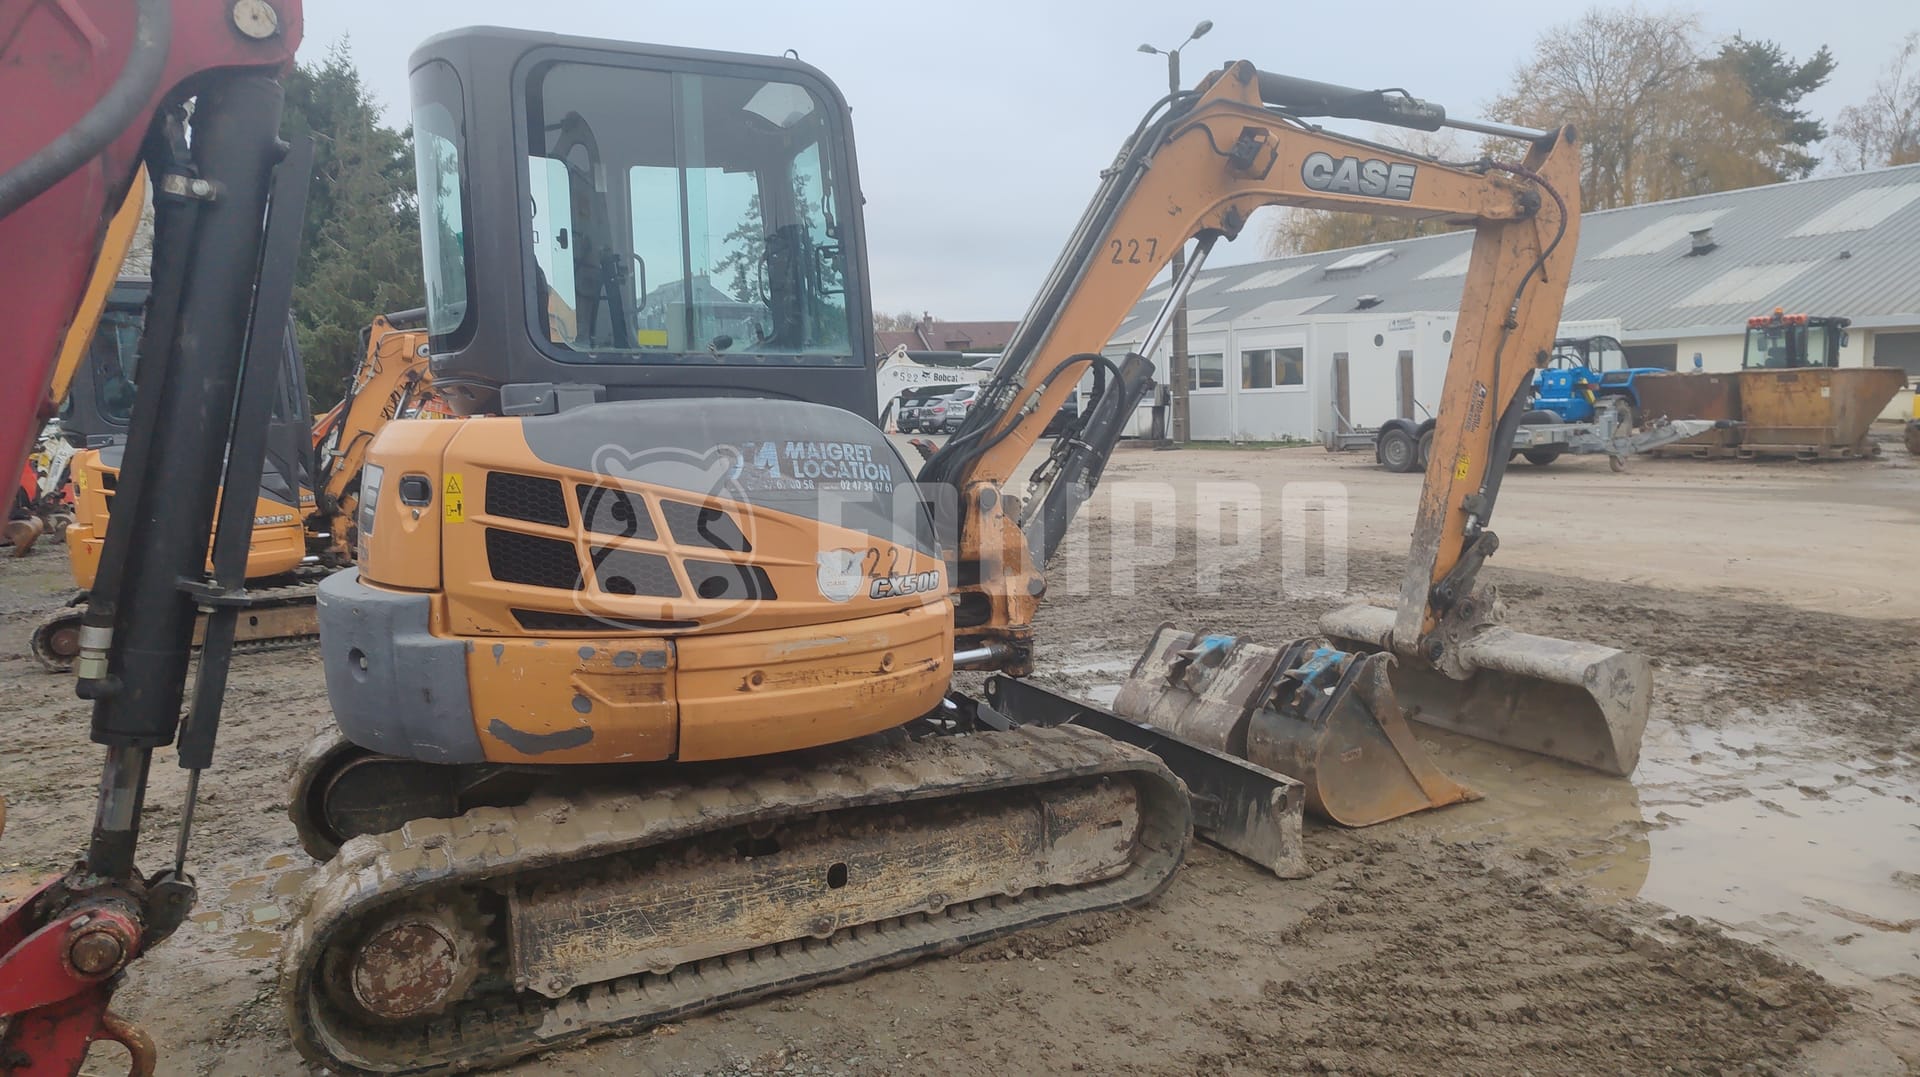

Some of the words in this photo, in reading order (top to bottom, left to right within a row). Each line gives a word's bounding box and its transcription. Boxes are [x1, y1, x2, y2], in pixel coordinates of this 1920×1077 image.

[1301, 151, 1418, 200] CASE
[1110, 237, 1158, 264] 227
[933, 373, 958, 382] Bobcat
[785, 441, 872, 462] MAIGRET
[793, 460, 891, 481] LOCATION
[840, 480, 851, 491] 02
[869, 570, 941, 600] CX50B
